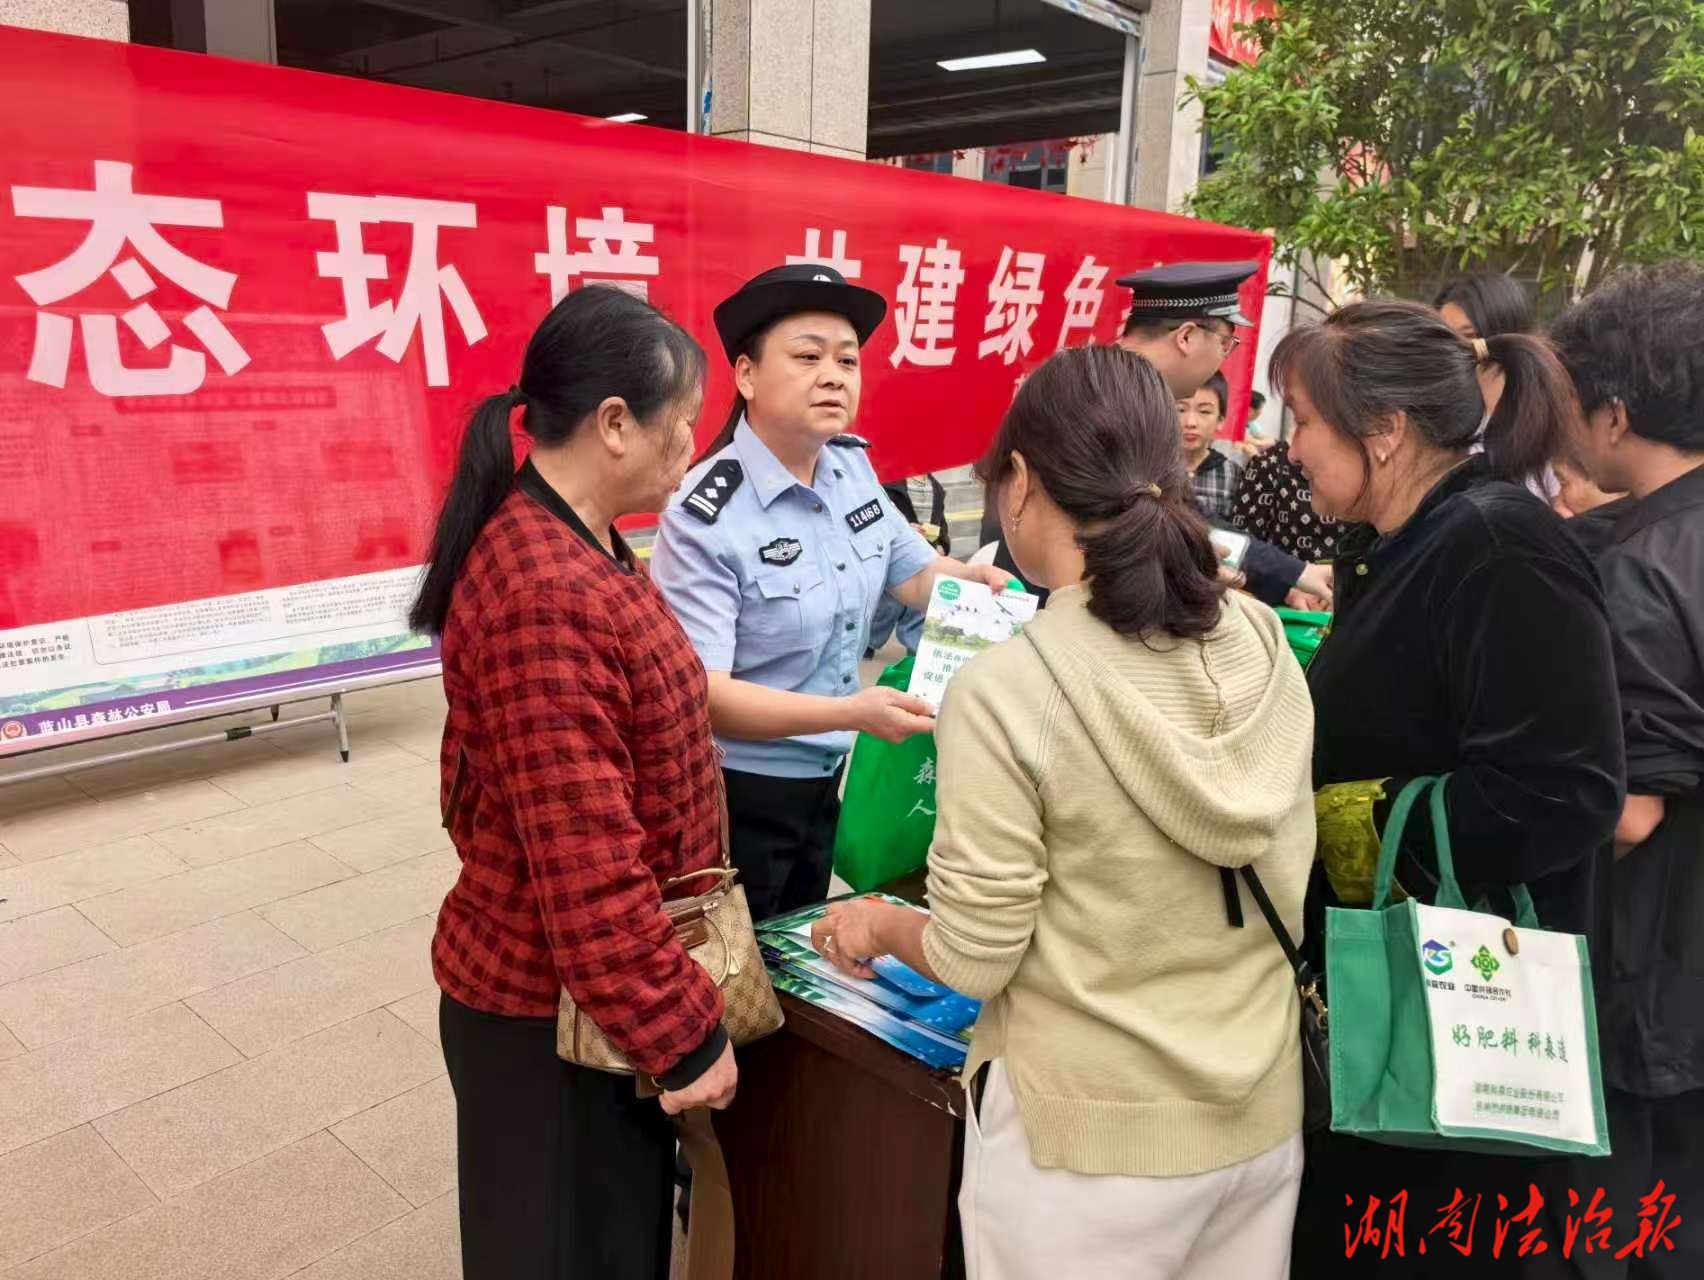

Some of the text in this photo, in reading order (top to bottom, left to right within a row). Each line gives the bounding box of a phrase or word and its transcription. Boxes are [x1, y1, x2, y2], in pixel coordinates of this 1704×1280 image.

[38, 700, 171, 737] 蓝山县森林公安局
